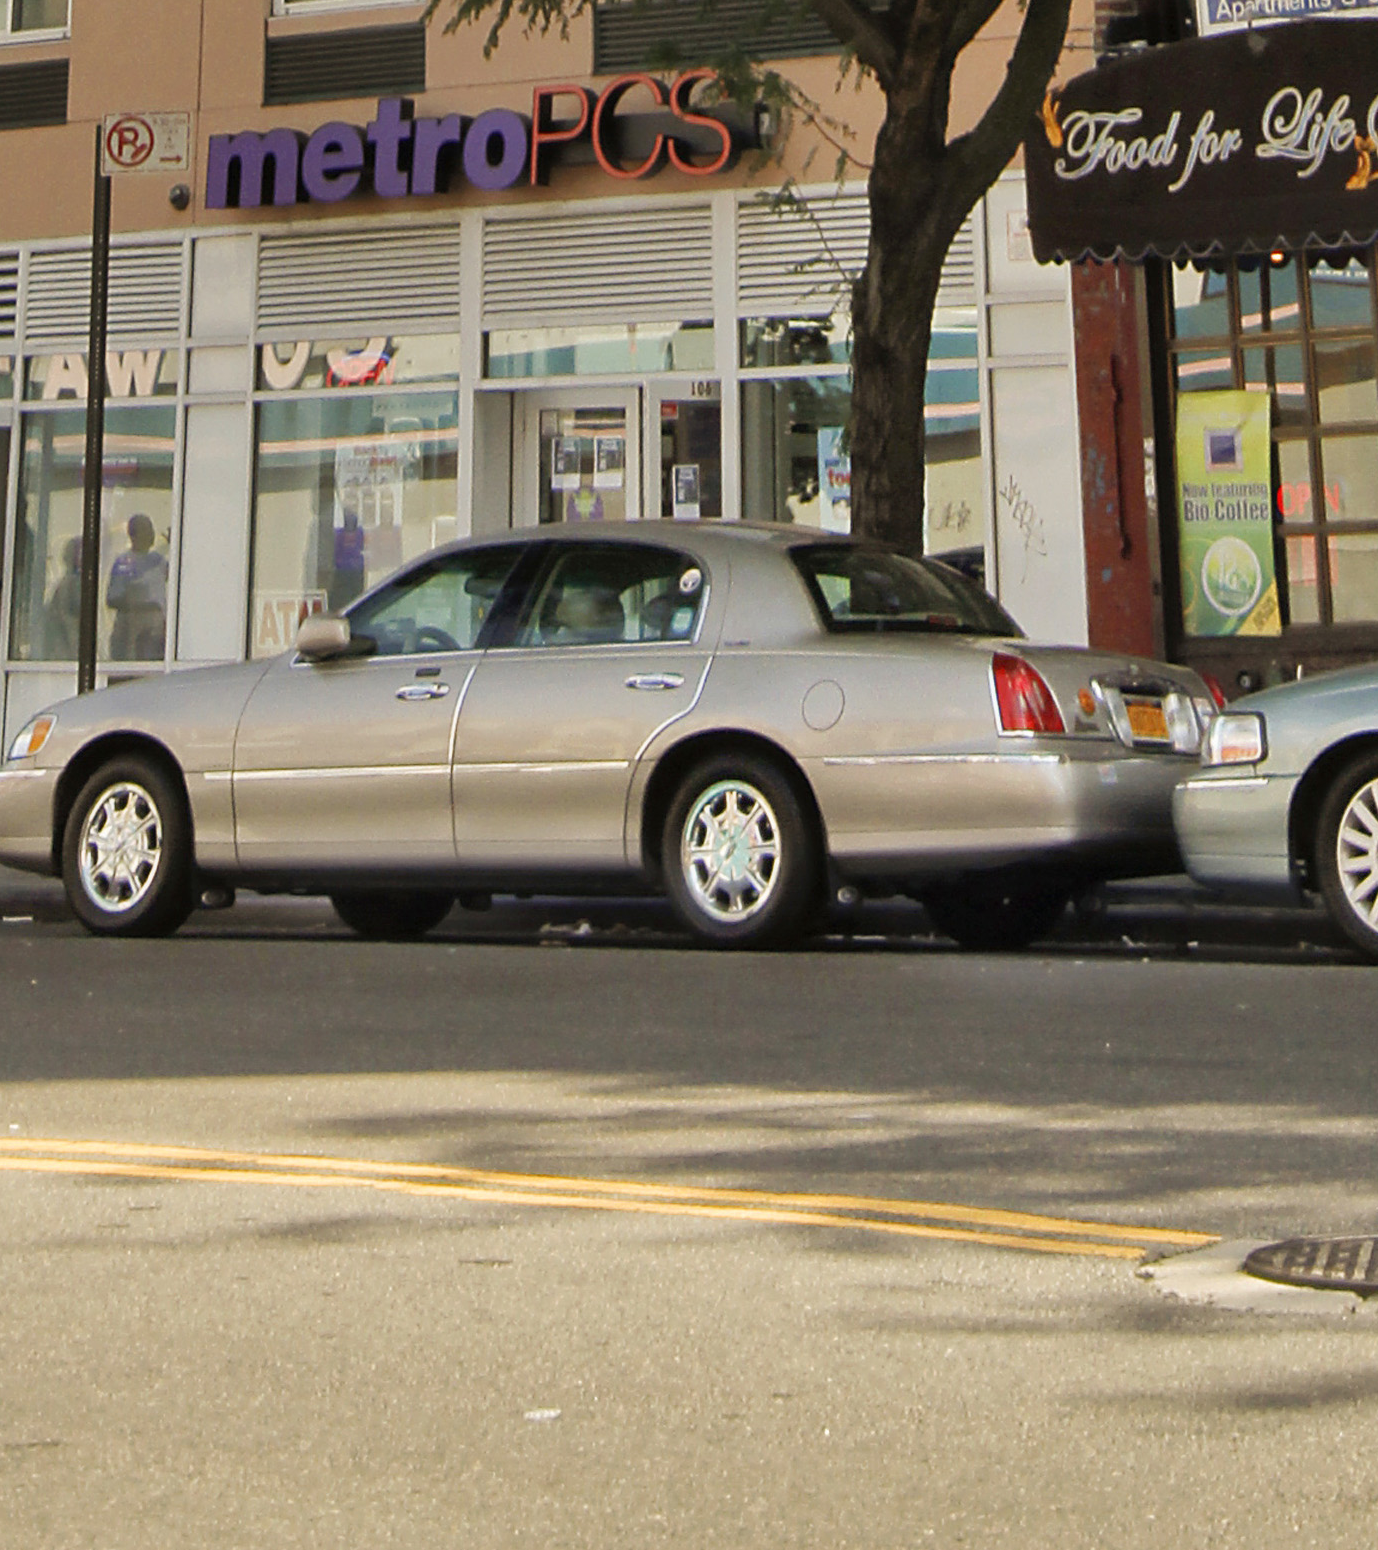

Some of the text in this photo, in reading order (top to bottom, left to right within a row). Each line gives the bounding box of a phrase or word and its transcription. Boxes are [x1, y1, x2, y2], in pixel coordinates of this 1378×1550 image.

[205, 69, 731, 210] metroPCS
[1056, 107, 1181, 179] Food
[1168, 110, 1242, 193] for
[1256, 86, 1357, 178] Life
[1182, 483, 1208, 499] Now
[1277, 482, 1340, 518] OPN
[1183, 499, 1269, 522] Bio Coffee
